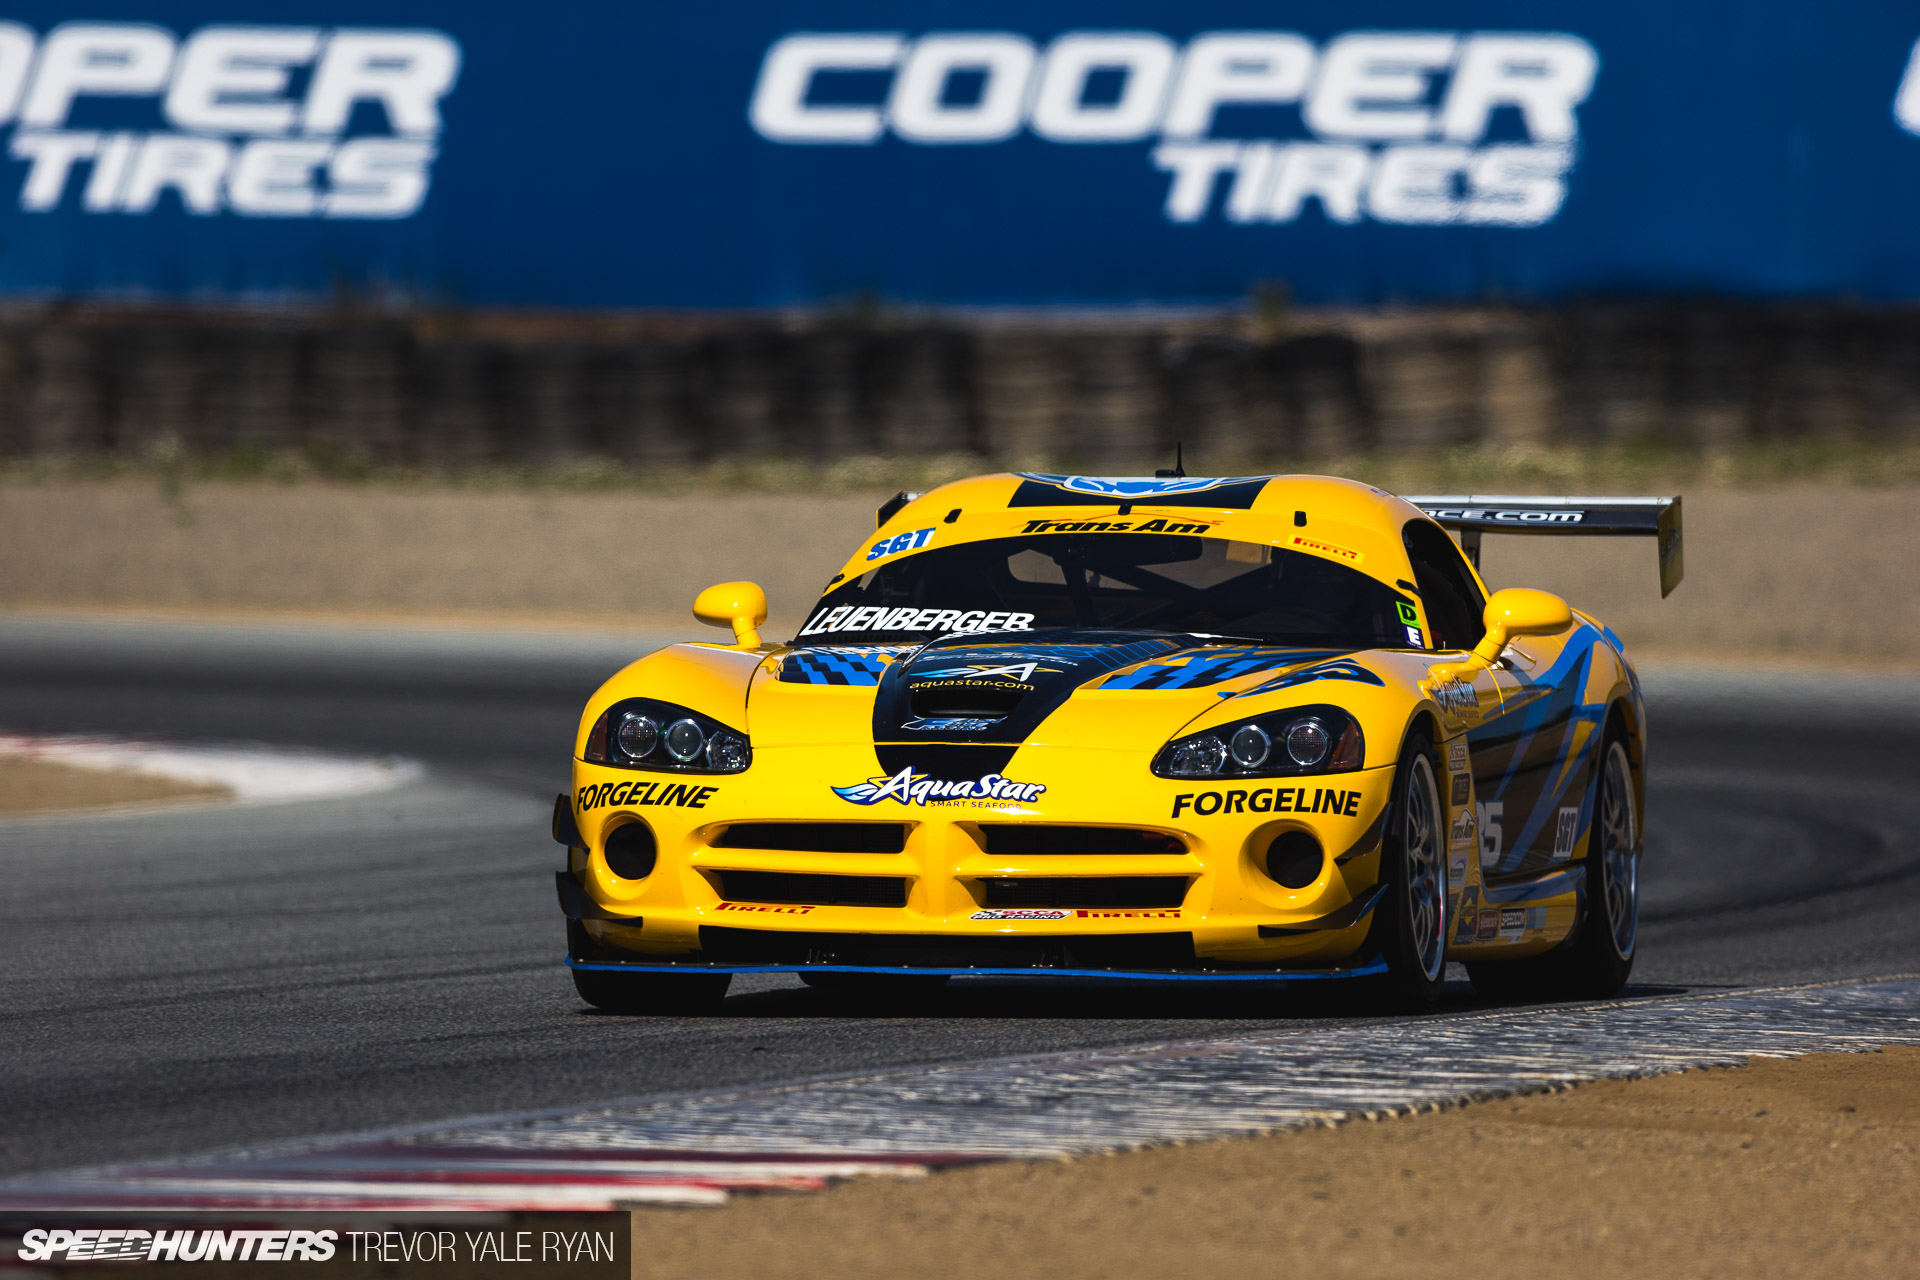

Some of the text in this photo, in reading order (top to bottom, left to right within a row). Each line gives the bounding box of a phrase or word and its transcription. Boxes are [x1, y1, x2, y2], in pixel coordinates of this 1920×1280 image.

[748, 31, 1600, 145] COOPER
[10, 130, 440, 219] TIRES
[1150, 141, 1578, 227] TIRES
[1020, 518, 1211, 534] Trans Am
[865, 527, 937, 562] SGT
[1293, 537, 1359, 560] PIRELLI
[799, 606, 1036, 637] LEUENBERGER
[1400, 603, 1417, 622] D
[1406, 625, 1422, 646] E
[909, 679, 1035, 691] aquastar.com
[576, 781, 720, 816] FORGELINE
[930, 800, 967, 808] SMART
[1171, 788, 1362, 819] FORGELINE
[714, 902, 816, 915] PIRELLI
[1076, 909, 1182, 919] PIRELLI
